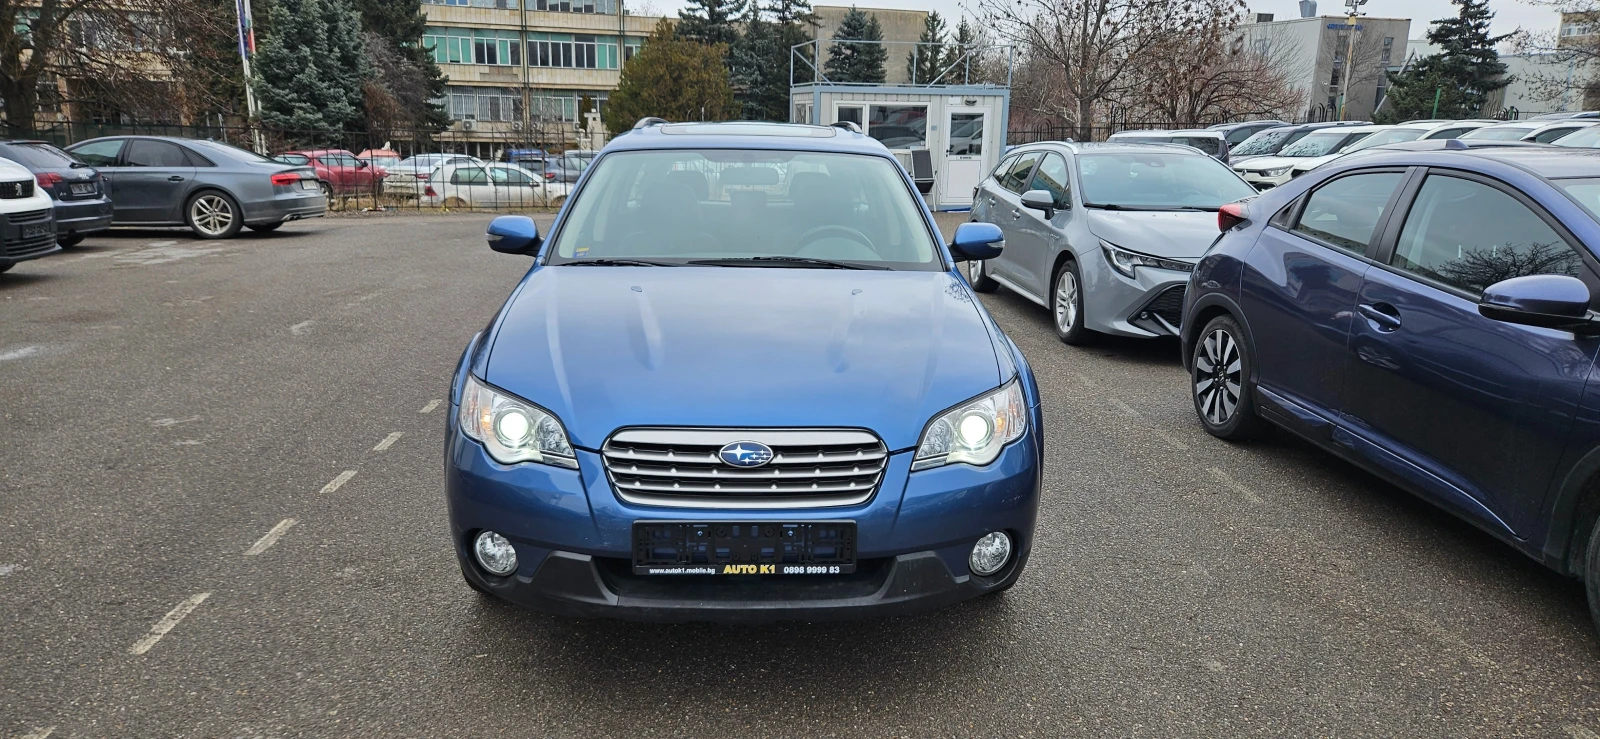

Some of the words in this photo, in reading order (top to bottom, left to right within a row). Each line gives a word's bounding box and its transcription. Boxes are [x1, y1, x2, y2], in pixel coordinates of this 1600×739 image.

[723, 564, 757, 574] AUTO
[759, 564, 776, 574] K1
[783, 566, 805, 574] 0898
[806, 566, 827, 574] 9999
[829, 566, 840, 574] 83
